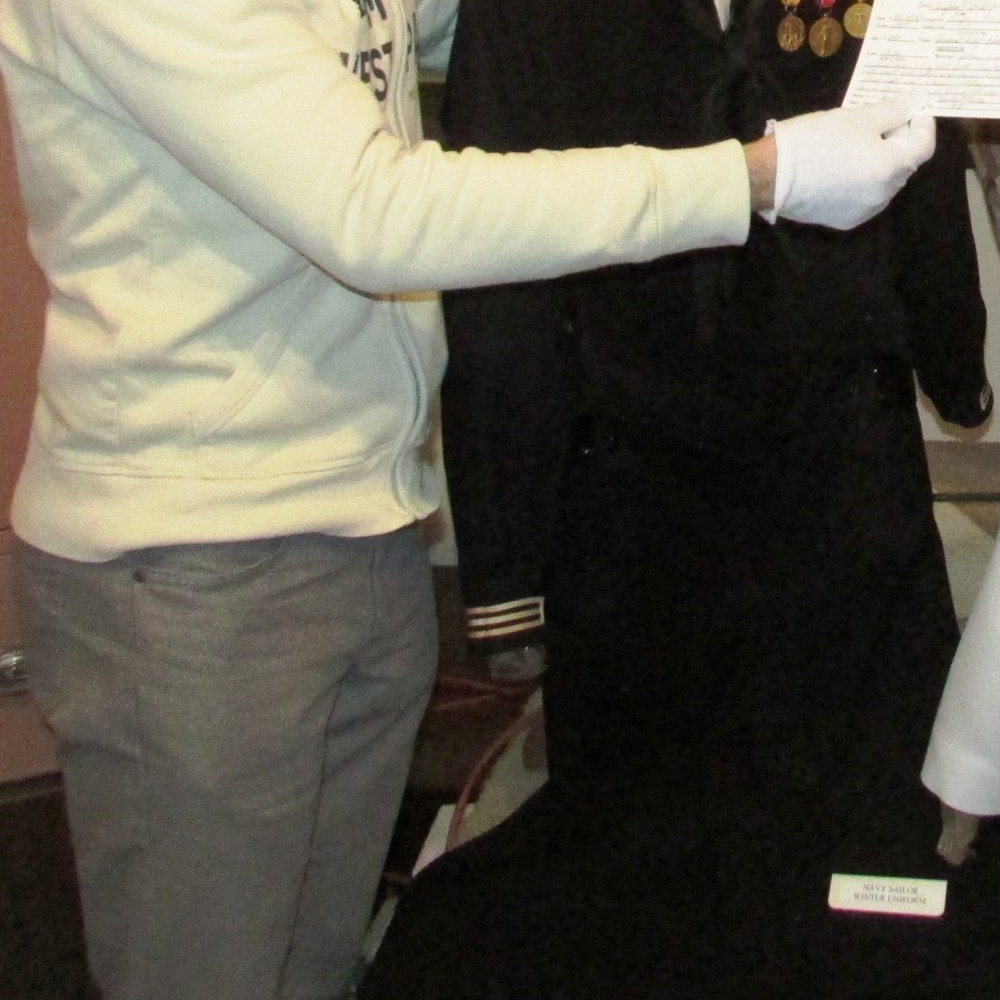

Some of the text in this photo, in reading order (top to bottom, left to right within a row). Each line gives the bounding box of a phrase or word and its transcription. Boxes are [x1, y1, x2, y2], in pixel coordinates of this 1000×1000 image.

[863, 883, 919, 894] NAVY SAILOR
[853, 892, 927, 904] WINTER UNIFORM
